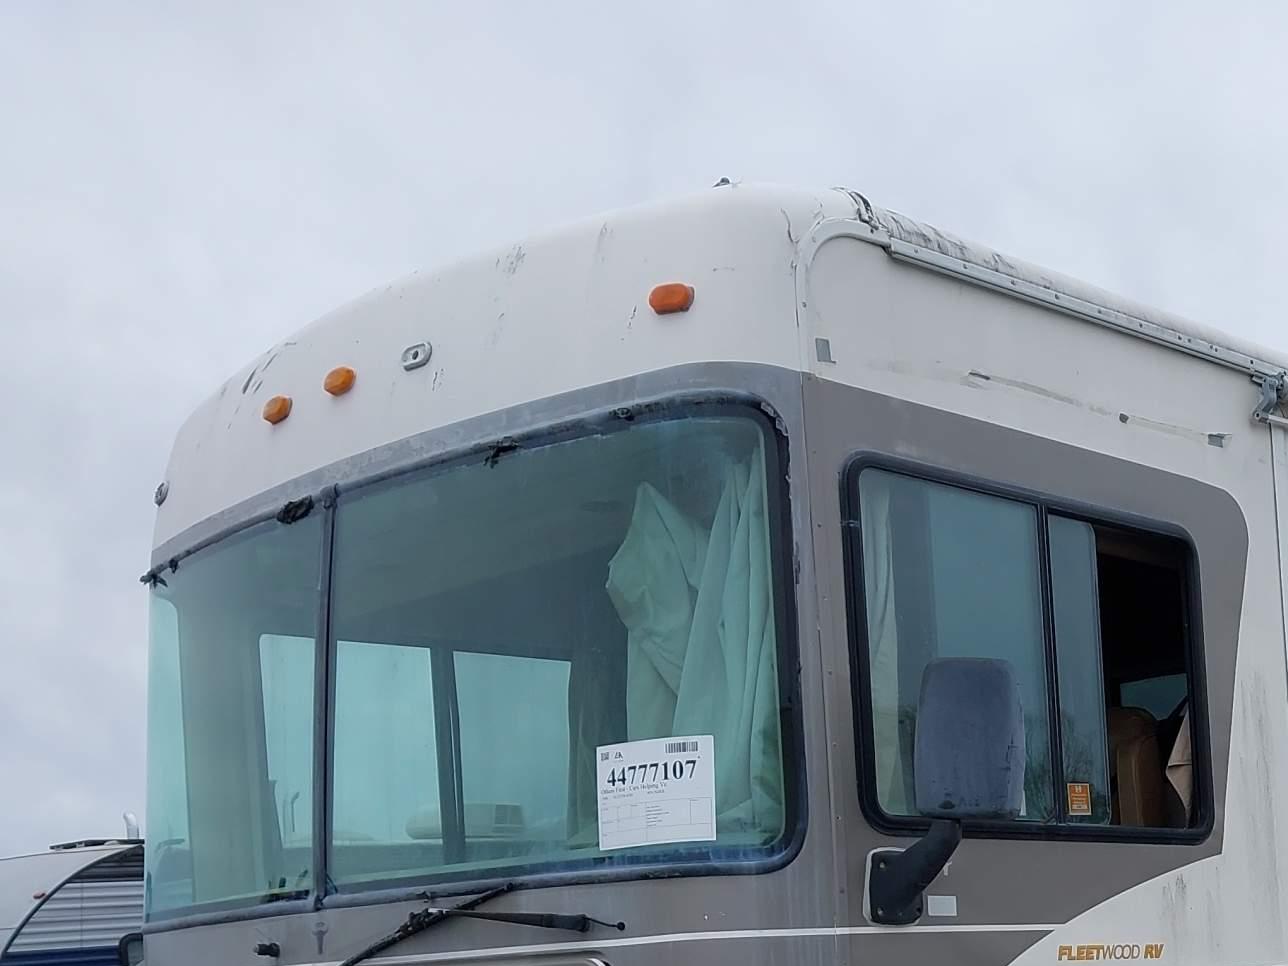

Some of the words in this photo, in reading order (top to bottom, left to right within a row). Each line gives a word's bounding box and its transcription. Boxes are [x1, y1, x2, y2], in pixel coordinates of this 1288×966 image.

[607, 760, 697, 787] 44777107
[1058, 943, 1141, 961] FLEETWOOD
[1143, 943, 1165, 959] RV
